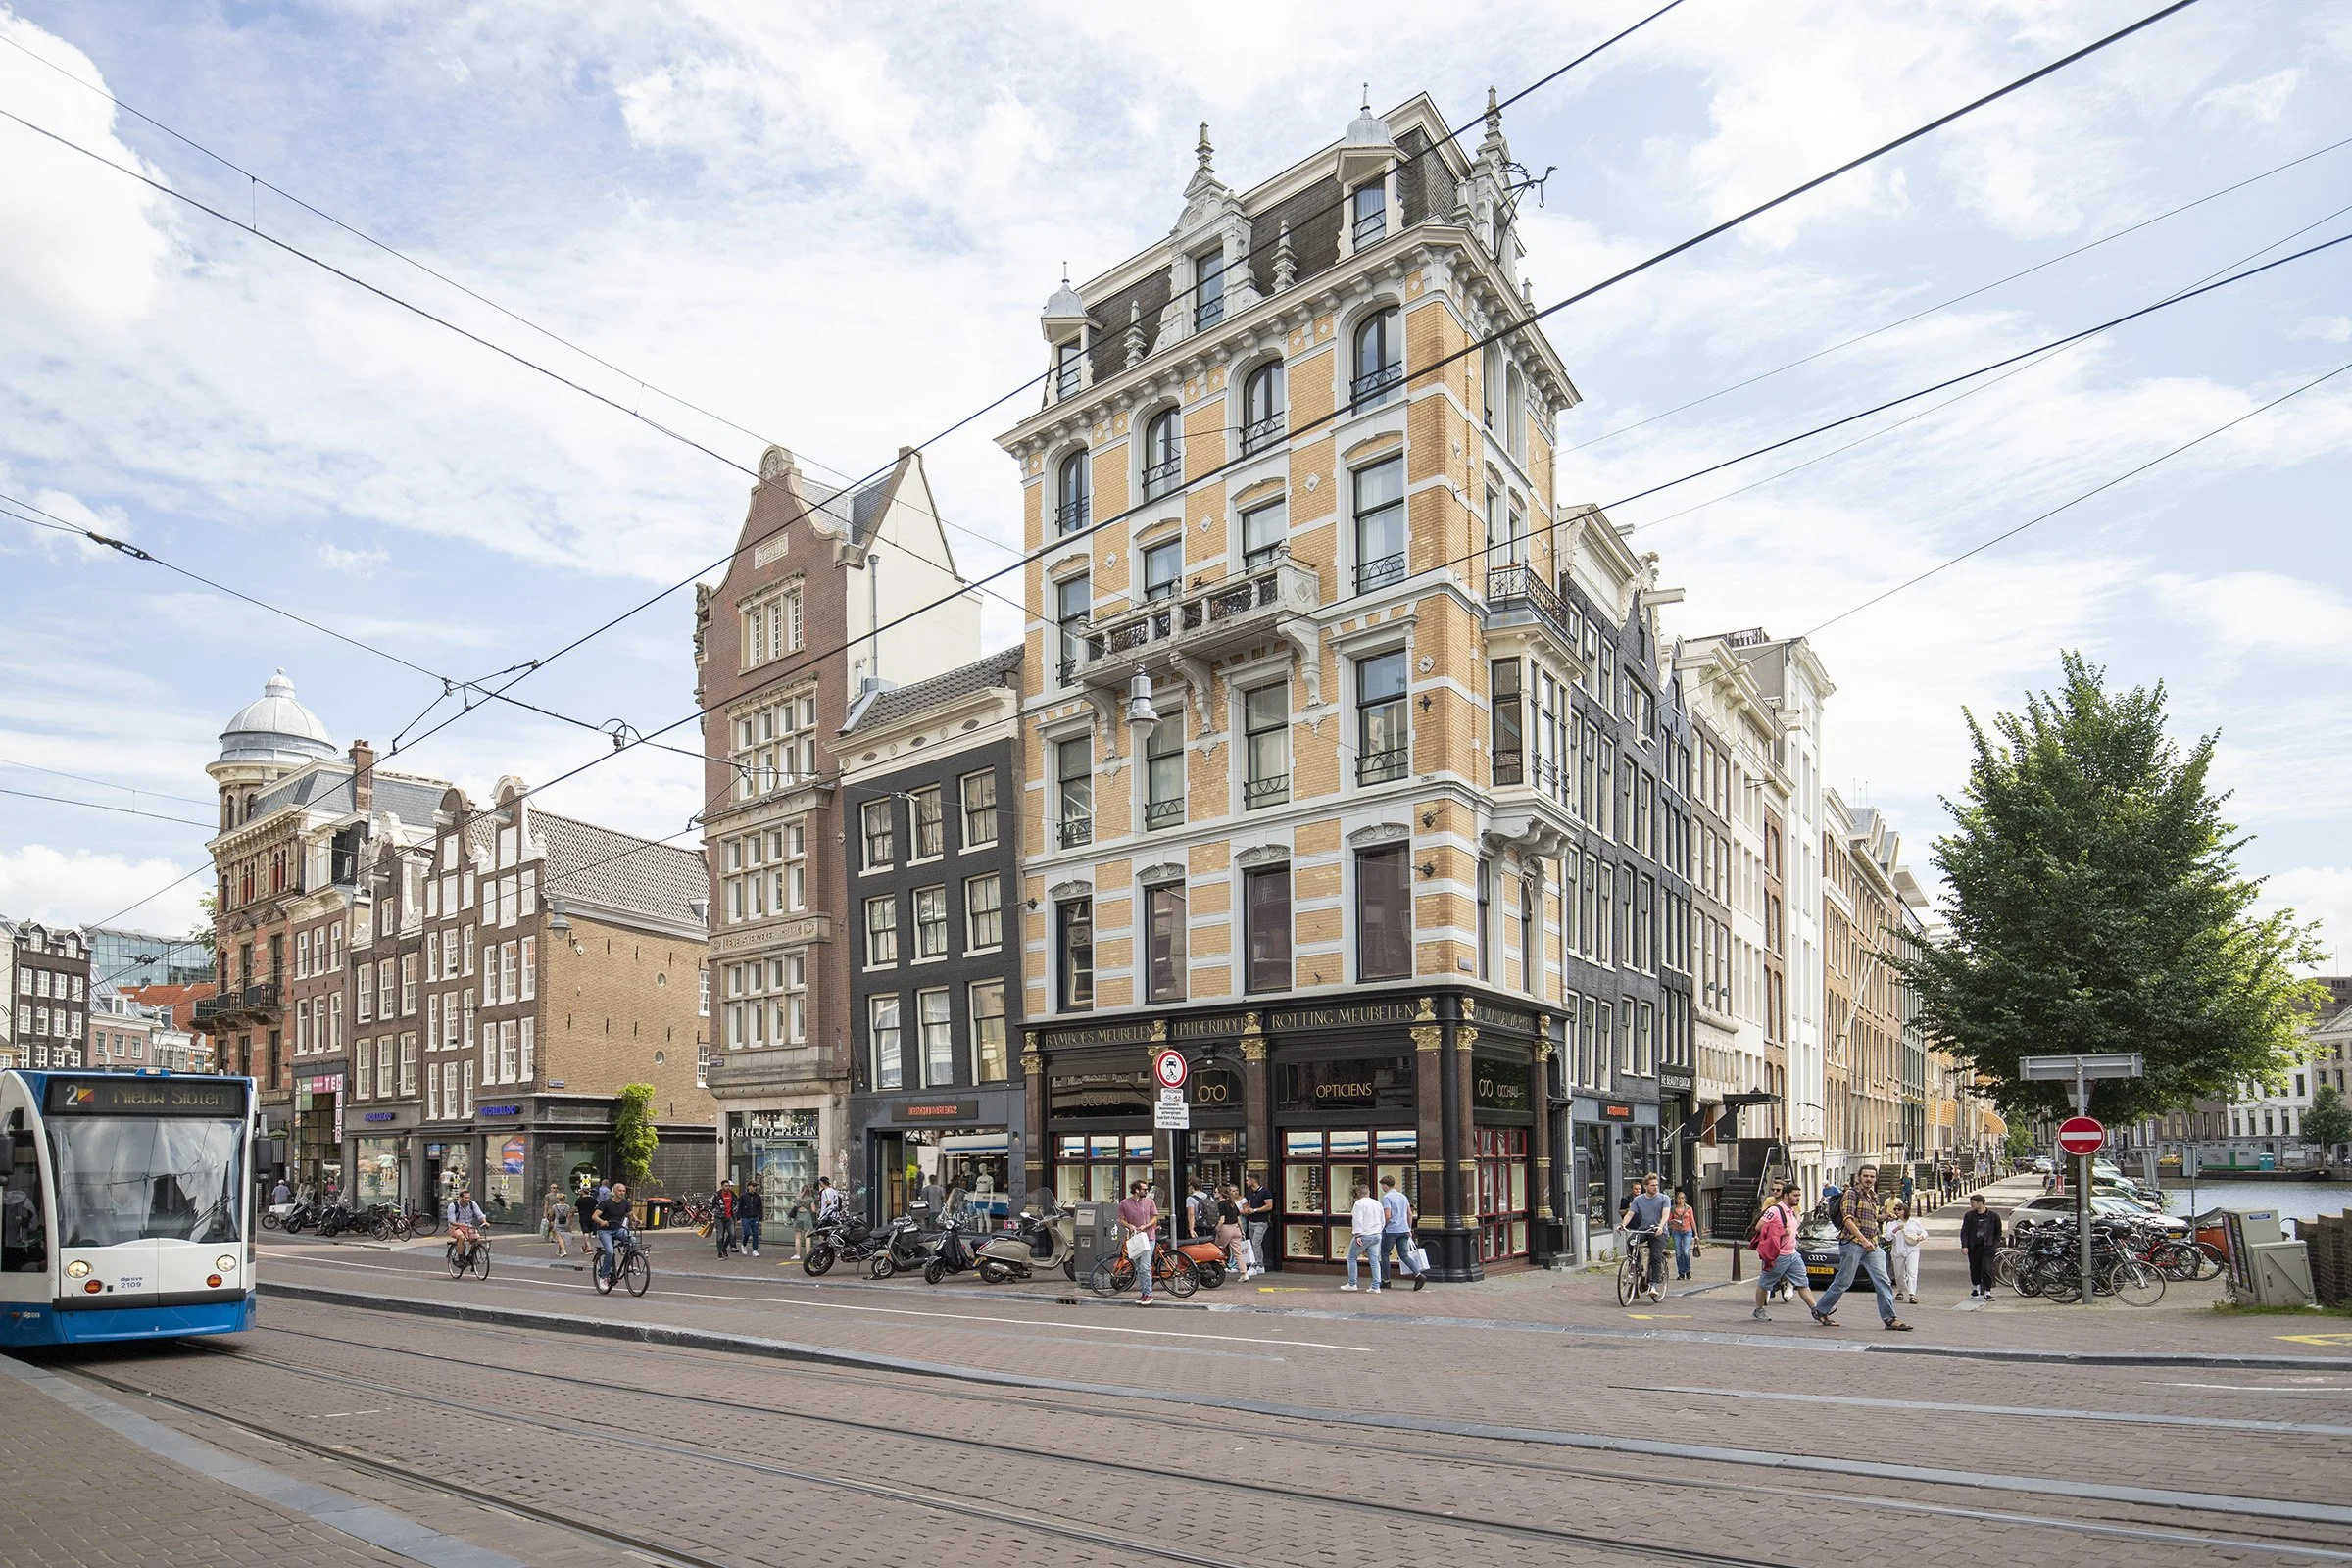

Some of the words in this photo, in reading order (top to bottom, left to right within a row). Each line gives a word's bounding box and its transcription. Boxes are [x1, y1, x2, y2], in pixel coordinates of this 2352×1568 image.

[1272, 1009, 1334, 1029] ROTTING
[1338, 1004, 1414, 1024] MEUBELEN
[1098, 1025, 1153, 1044] MEUBELEN
[66, 1084, 78, 1106] 2
[1316, 1082, 1373, 1099] OPTICIENS
[731, 1128, 775, 1138] PHILIPP
[781, 1125, 818, 1137] PLEIN
